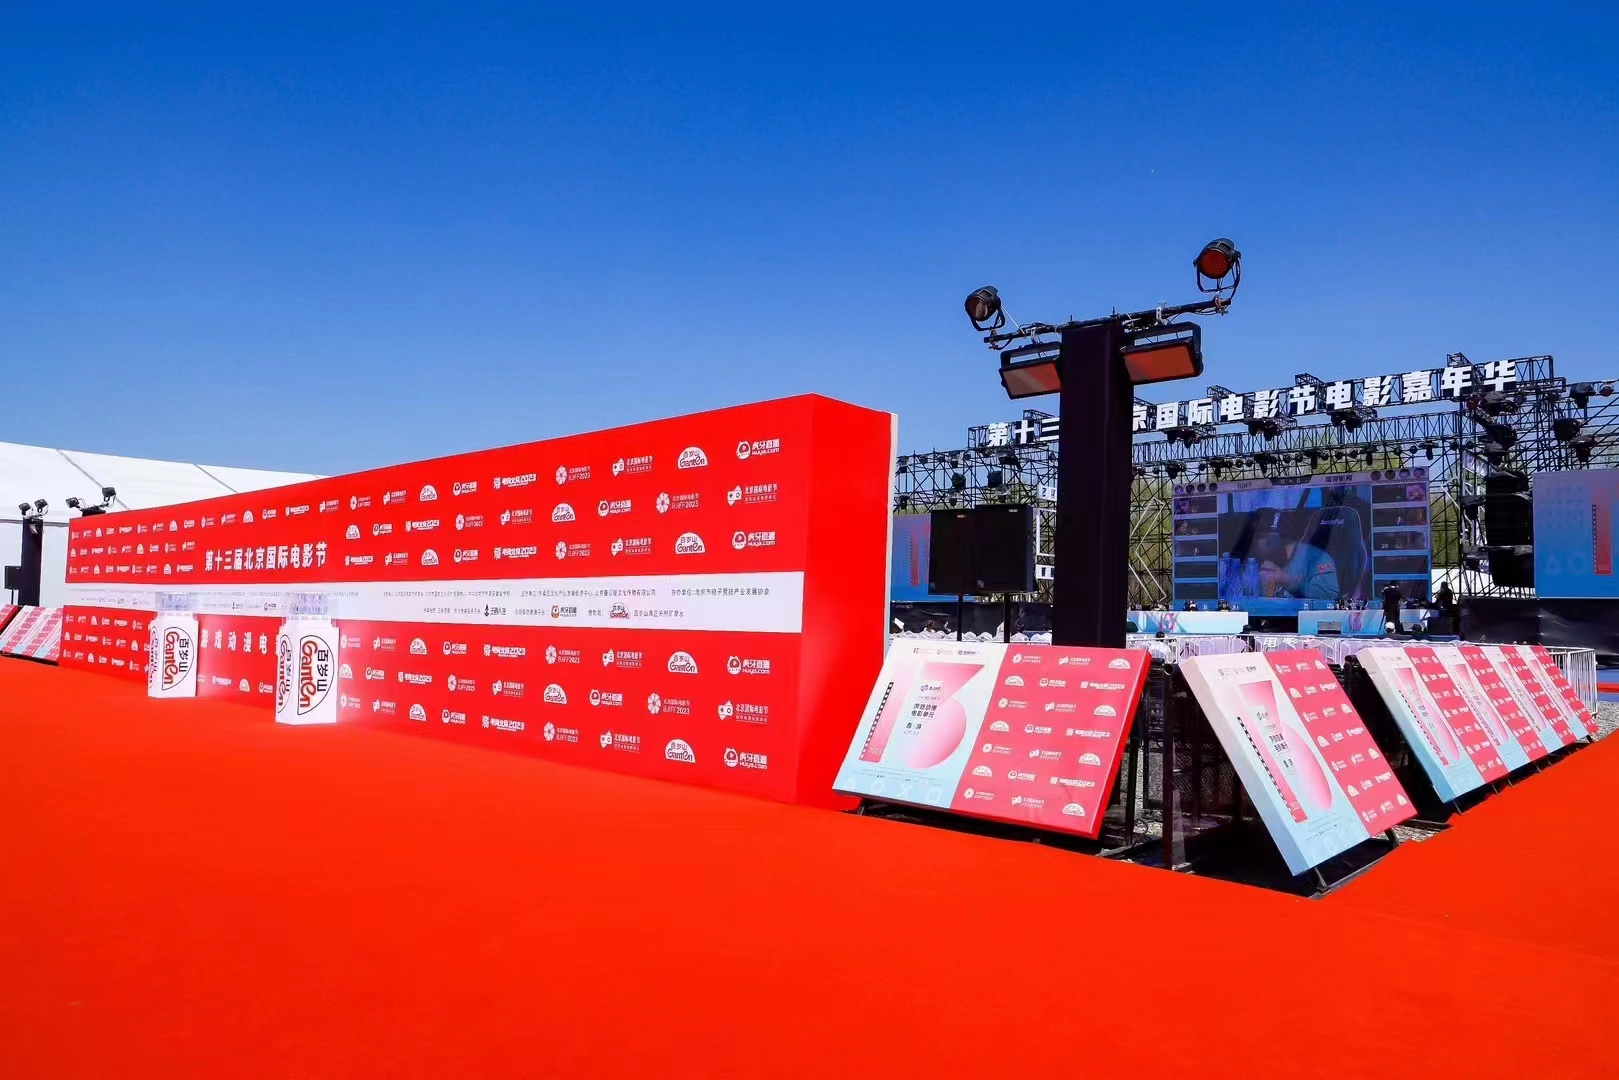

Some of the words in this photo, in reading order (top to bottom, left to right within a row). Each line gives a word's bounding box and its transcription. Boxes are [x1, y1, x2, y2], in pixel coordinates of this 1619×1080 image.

[205, 541, 327, 572] 第十三届北京国际电影节
[178, 638, 190, 673] 百岁山
[316, 649, 329, 692] 百岁山
